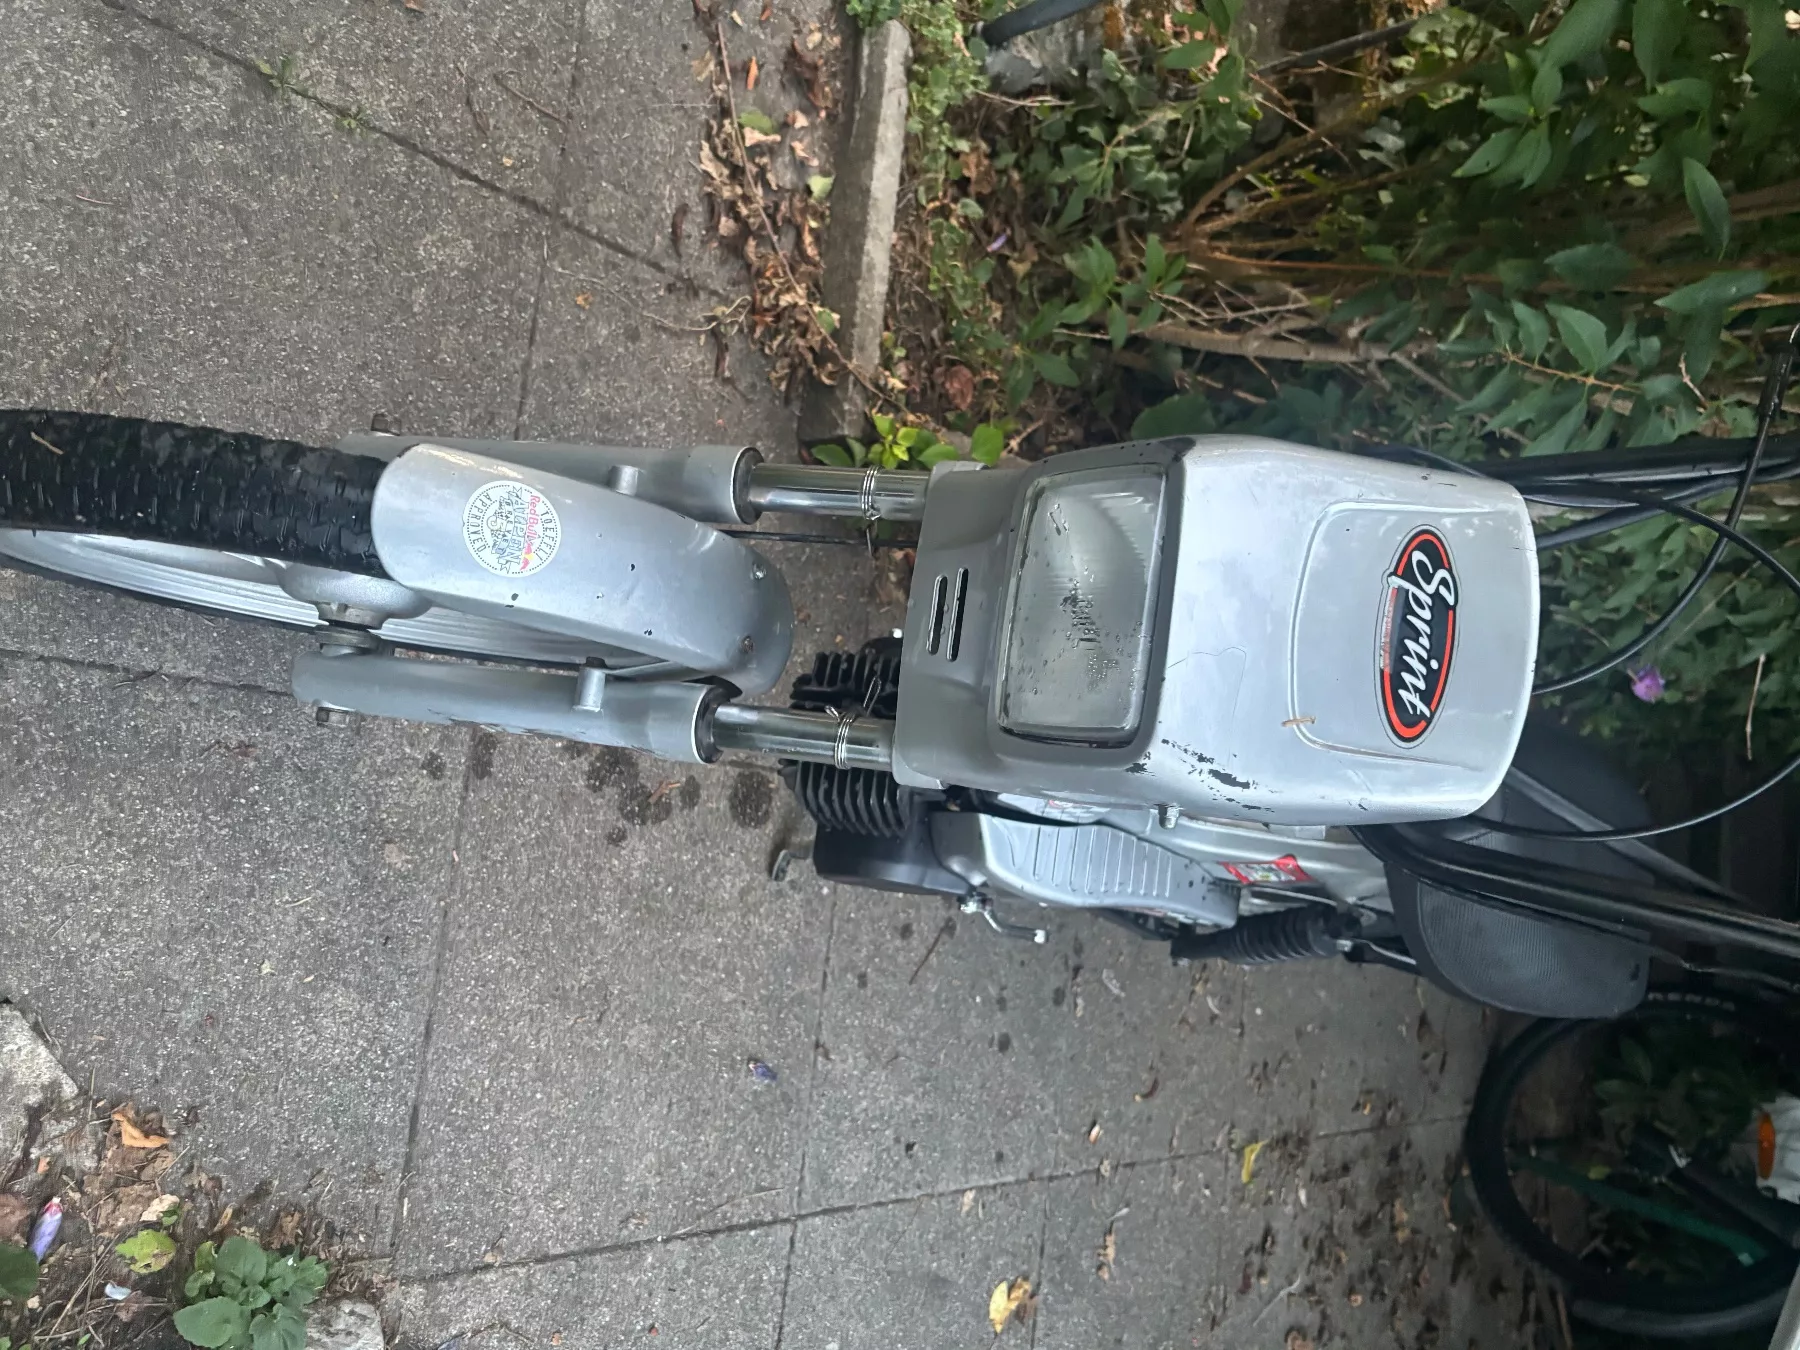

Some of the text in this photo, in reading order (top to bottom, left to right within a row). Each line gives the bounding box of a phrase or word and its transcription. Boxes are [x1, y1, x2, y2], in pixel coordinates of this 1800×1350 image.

[470, 492, 492, 553] APPROVED
[497, 501, 513, 552] BREVET
[535, 510, 555, 561] TOEFFLI
[1387, 550, 1455, 718] Sprint
